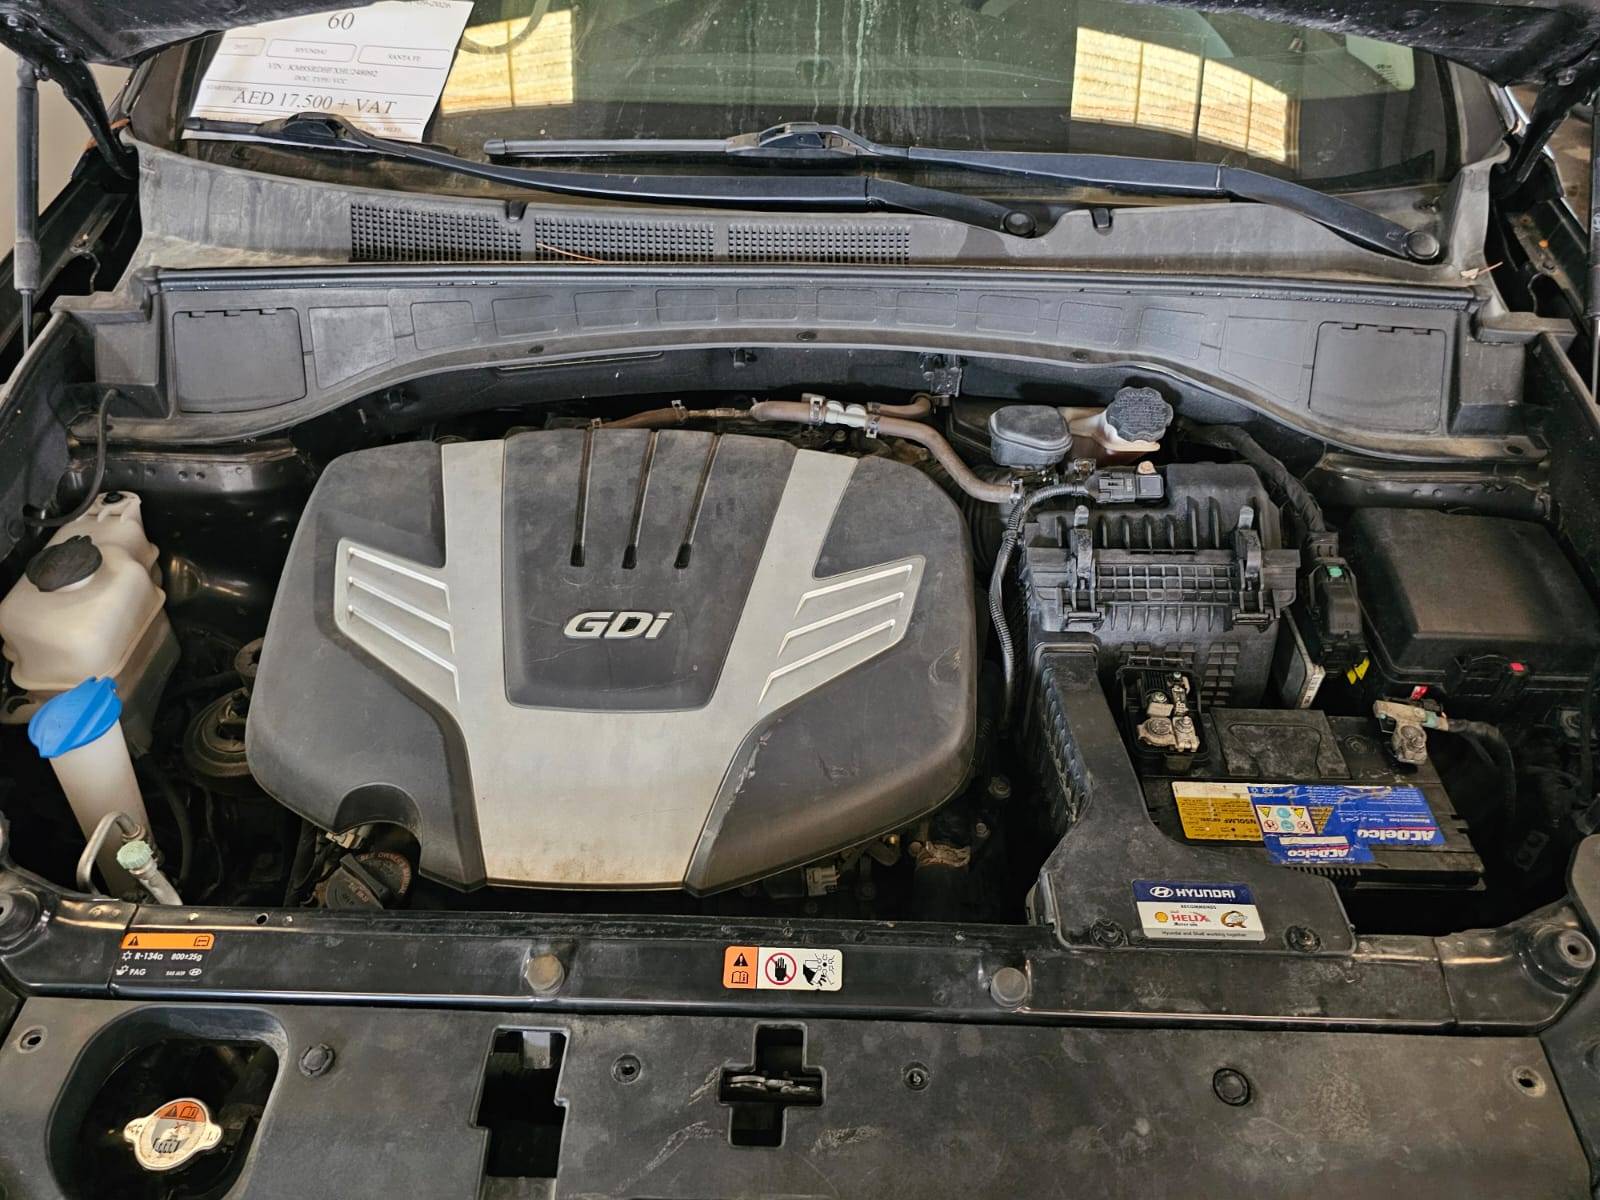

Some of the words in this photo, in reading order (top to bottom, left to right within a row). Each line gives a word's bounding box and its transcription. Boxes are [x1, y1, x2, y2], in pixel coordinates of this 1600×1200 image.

[328, 12, 355, 30] 60
[232, 91, 274, 106] AED
[337, 99, 349, 110] +
[356, 98, 398, 114] VAT
[563, 611, 673, 639] GDi
[1356, 828, 1435, 841] ACDelco
[1287, 848, 1349, 858] ACDelco
[1175, 888, 1236, 899] HYUNDAI
[1171, 912, 1211, 922] HELIX
[133, 952, 164, 961] R-134a
[128, 968, 147, 976] PAG
